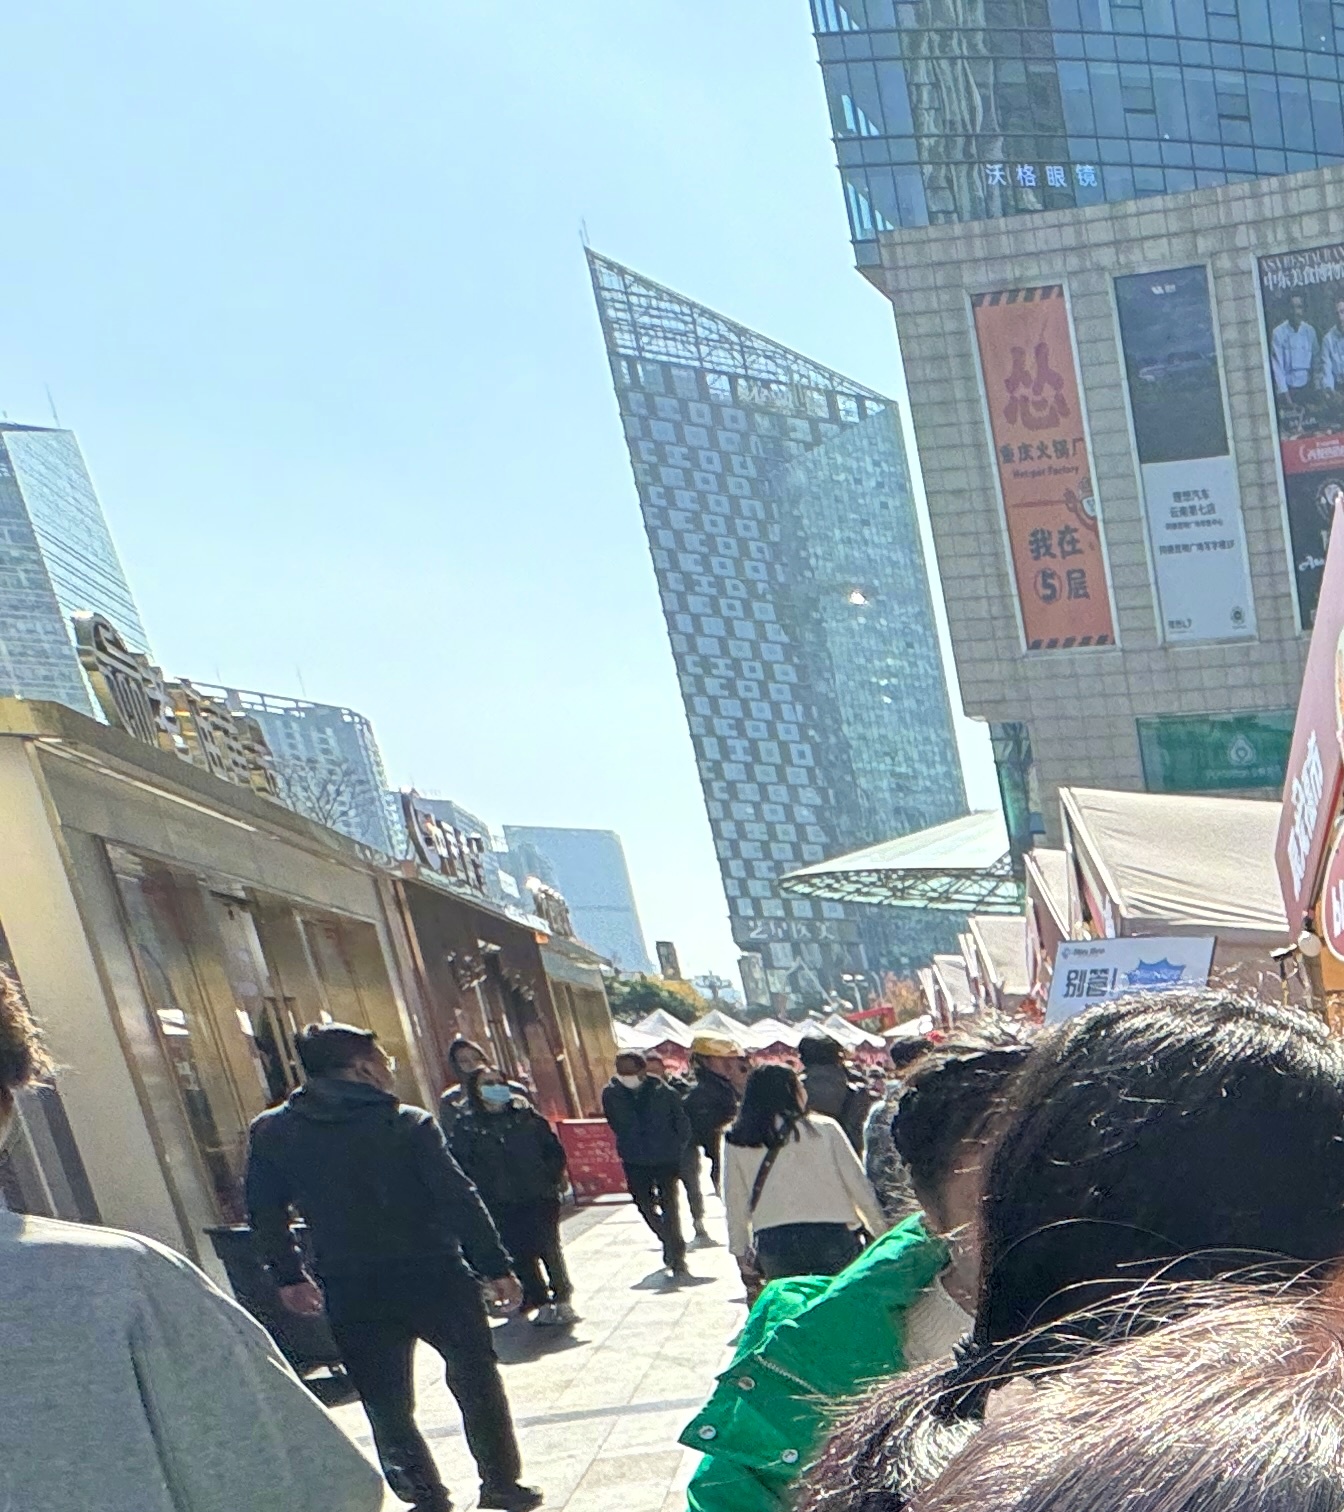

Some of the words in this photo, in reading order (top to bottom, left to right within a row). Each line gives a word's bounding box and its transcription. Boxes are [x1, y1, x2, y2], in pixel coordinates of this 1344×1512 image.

[1001, 437, 1085, 465] 重庆火锅厂
[1028, 525, 1082, 562] 我在
[1036, 567, 1090, 604] 5层
